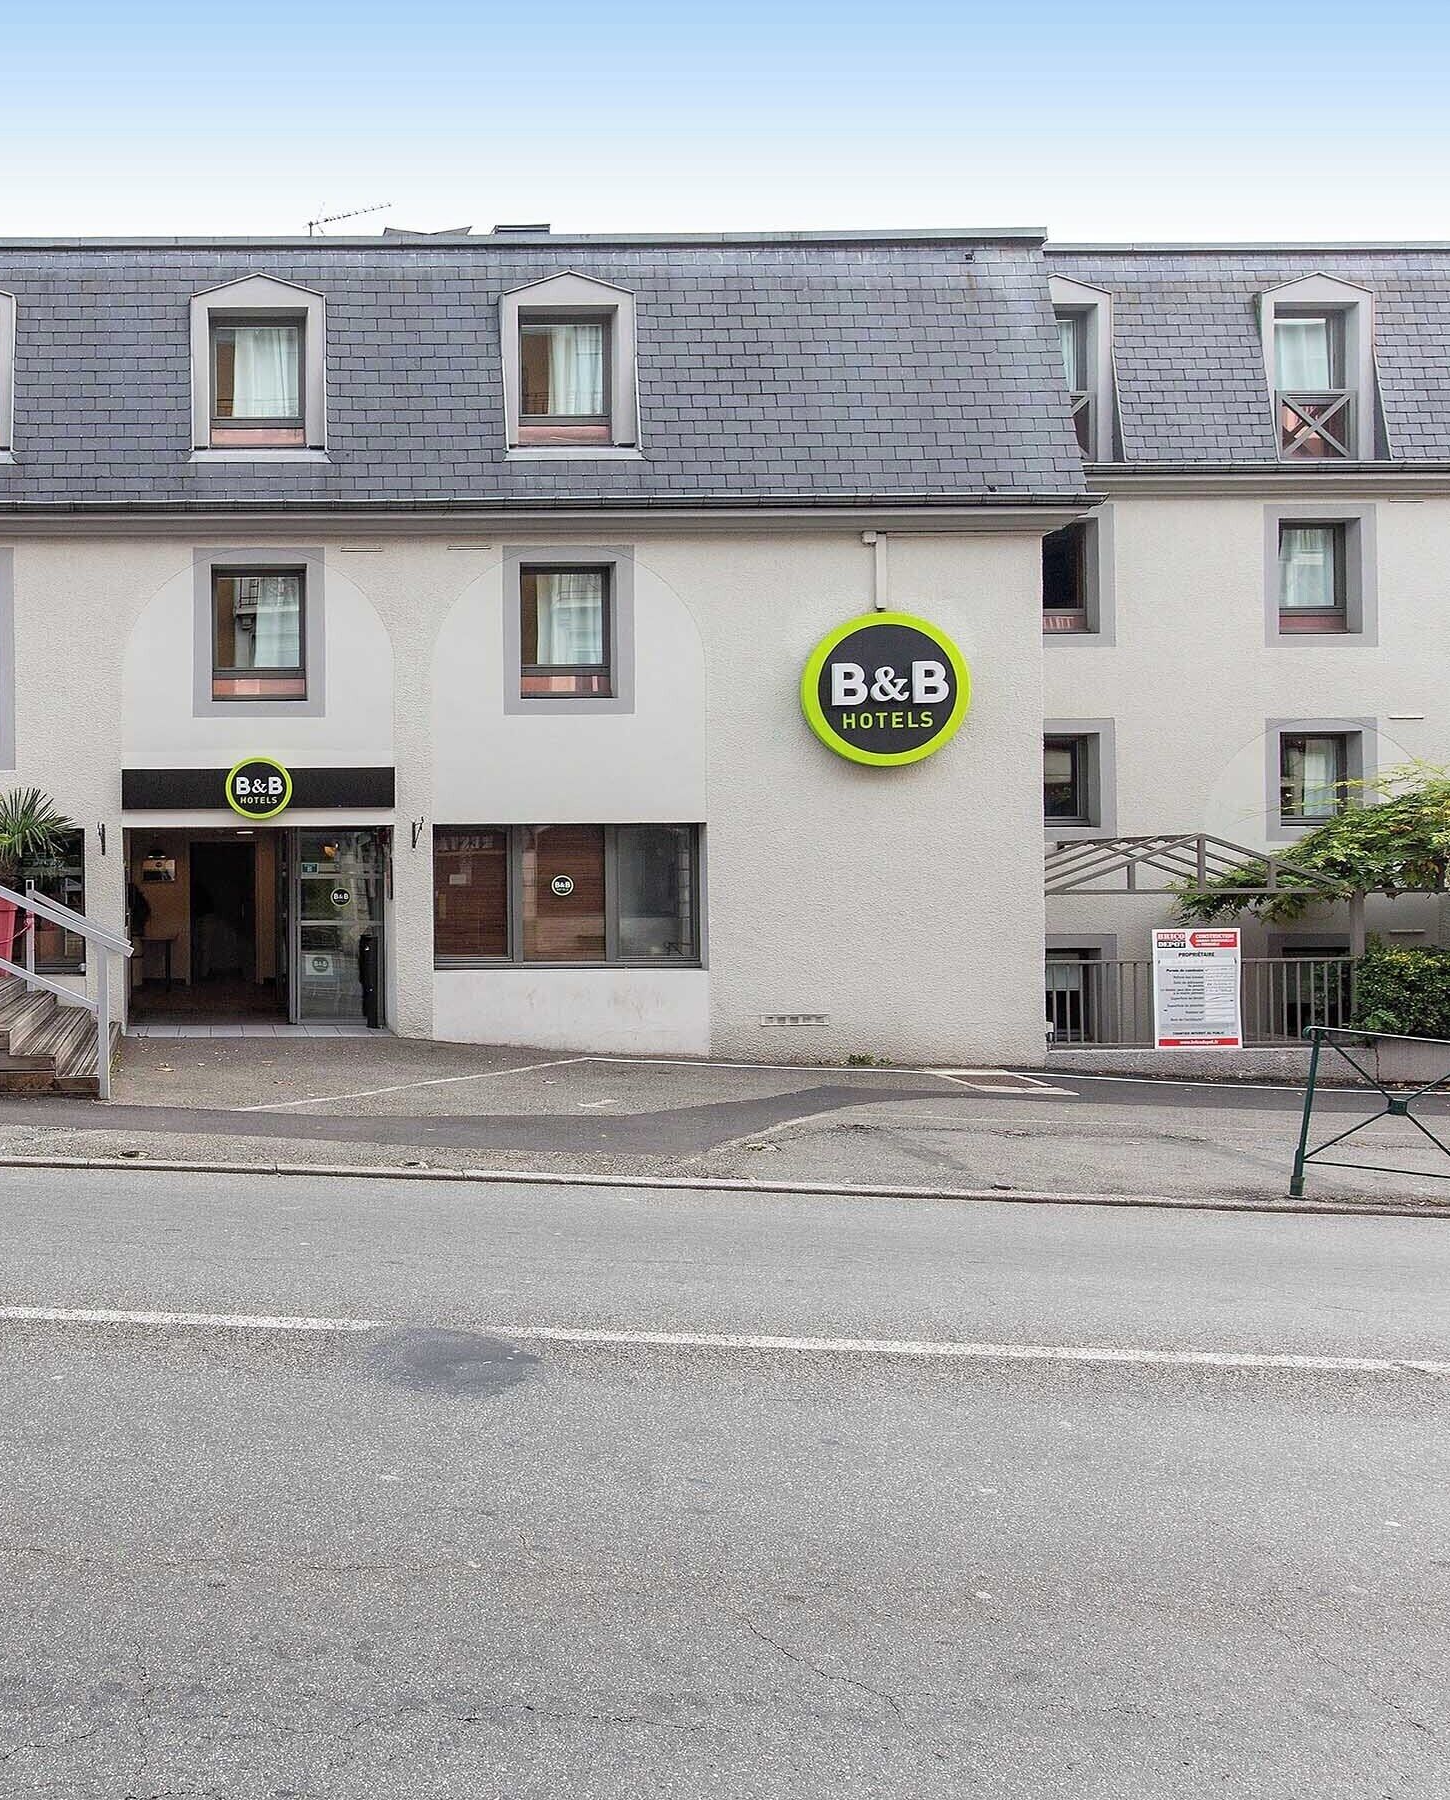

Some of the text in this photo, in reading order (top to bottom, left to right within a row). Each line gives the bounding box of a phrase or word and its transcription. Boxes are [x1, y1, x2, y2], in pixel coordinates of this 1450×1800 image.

[831, 660, 949, 706] B&B
[842, 711, 934, 729] HOTELS
[236, 776, 283, 795] B&B
[240, 796, 278, 804] HOTELS
